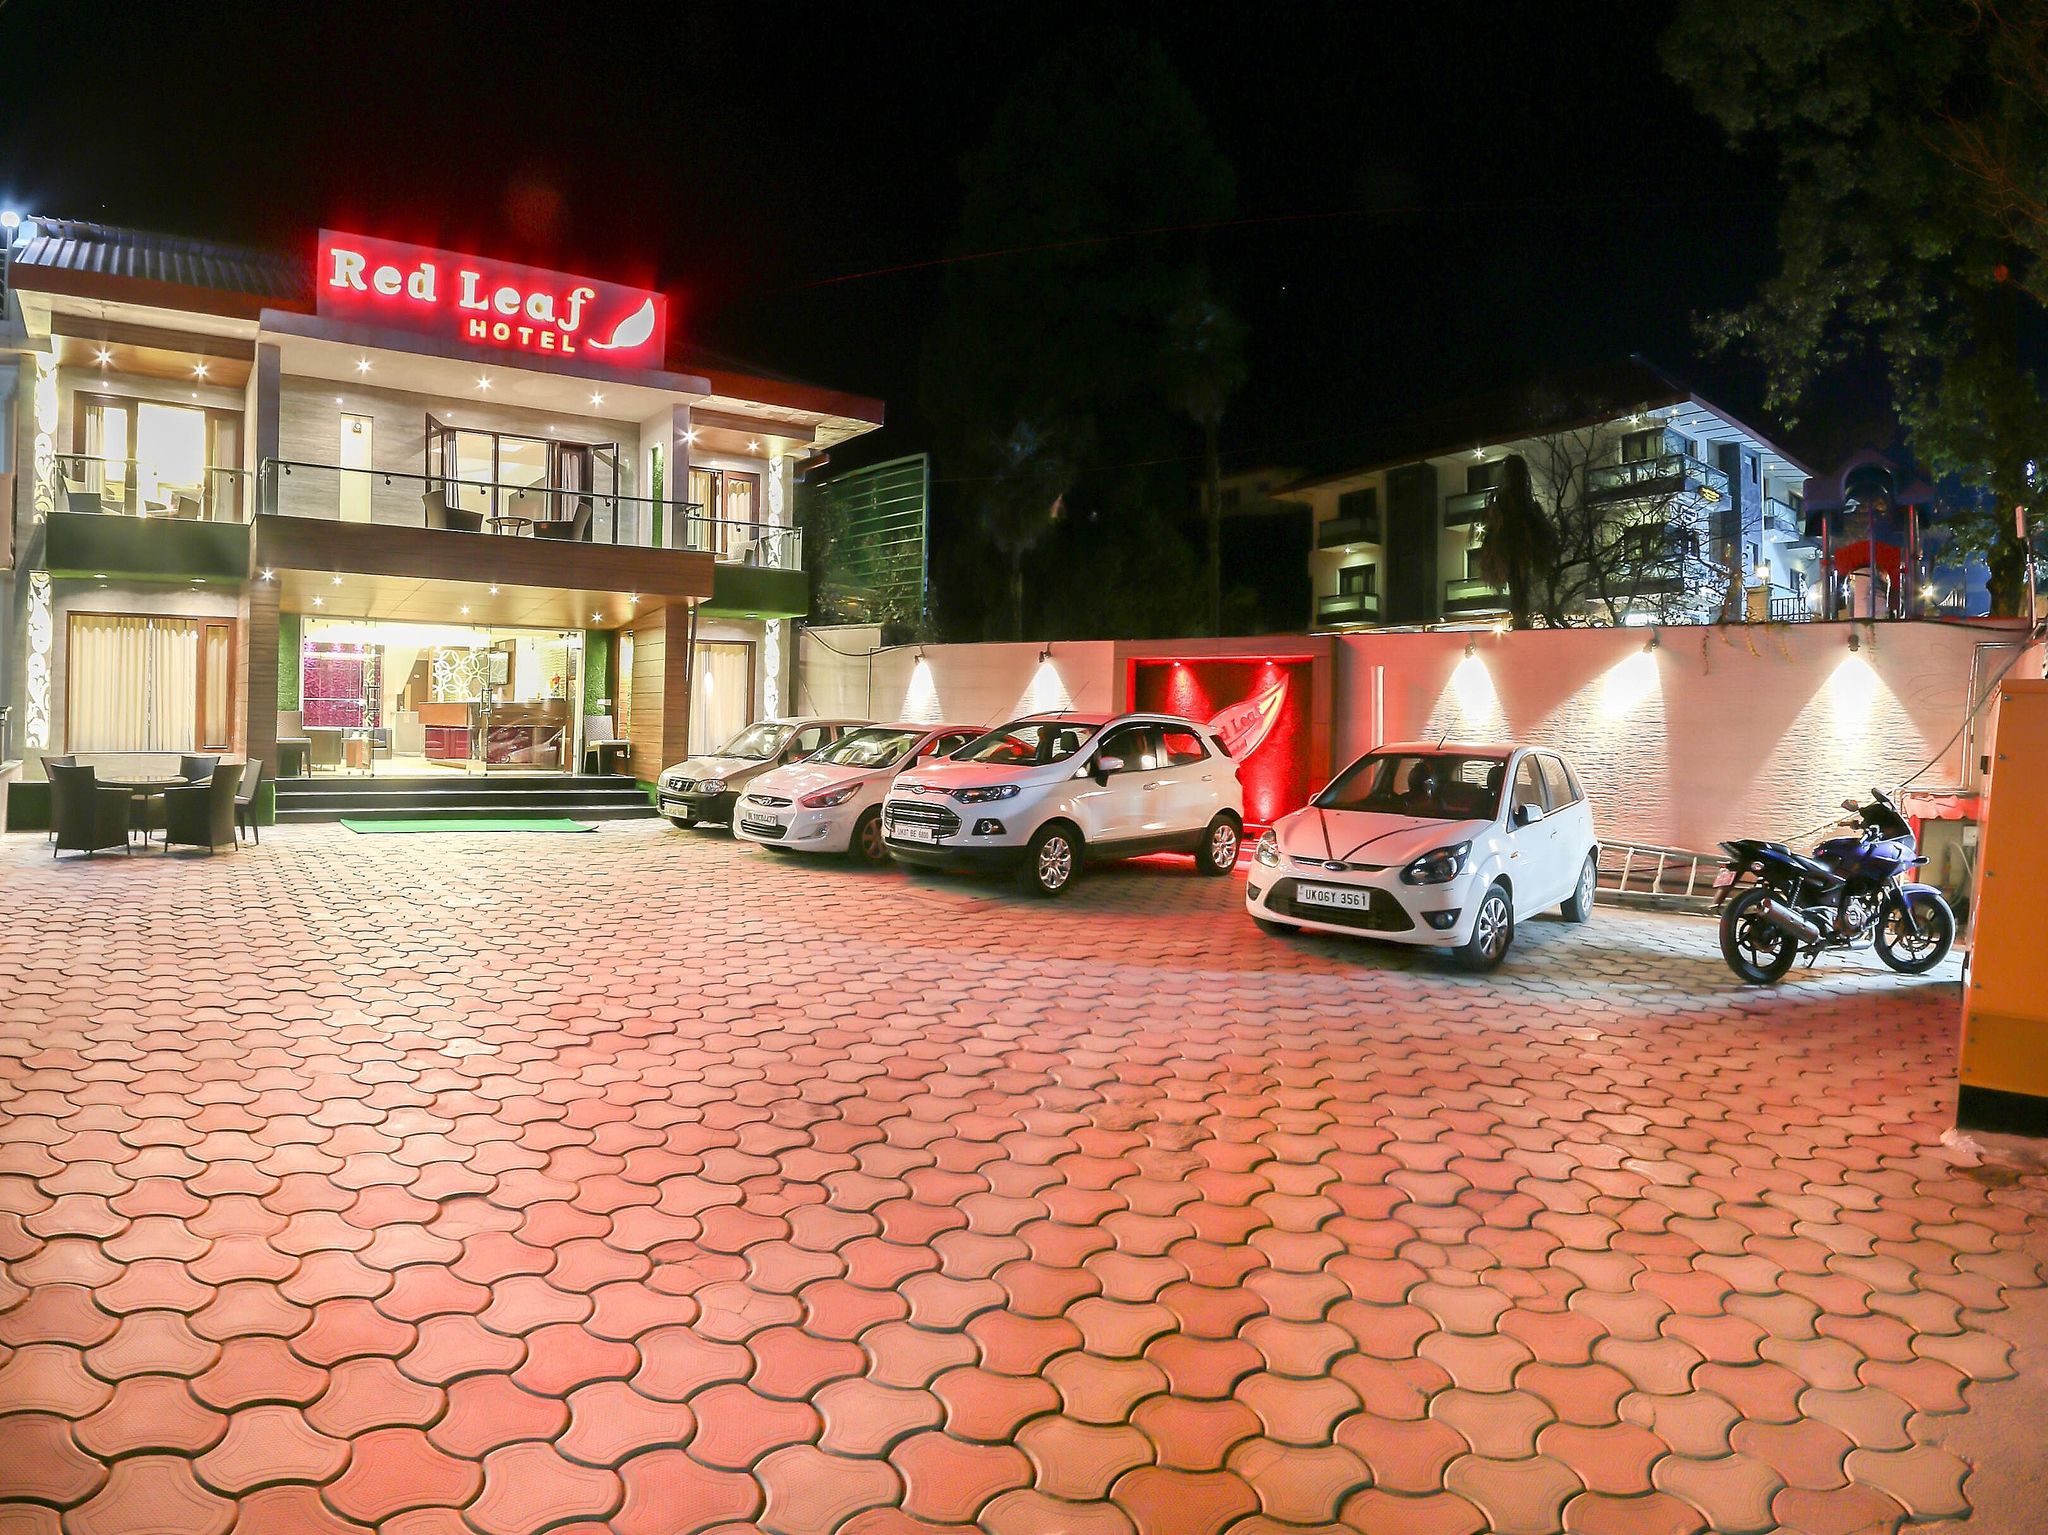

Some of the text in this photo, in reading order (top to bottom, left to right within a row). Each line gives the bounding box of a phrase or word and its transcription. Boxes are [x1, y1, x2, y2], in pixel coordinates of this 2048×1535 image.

[329, 248, 595, 332] Red Leaf
[469, 319, 576, 353] HOTEL
[1305, 889, 1366, 906] UK06Y 3561
